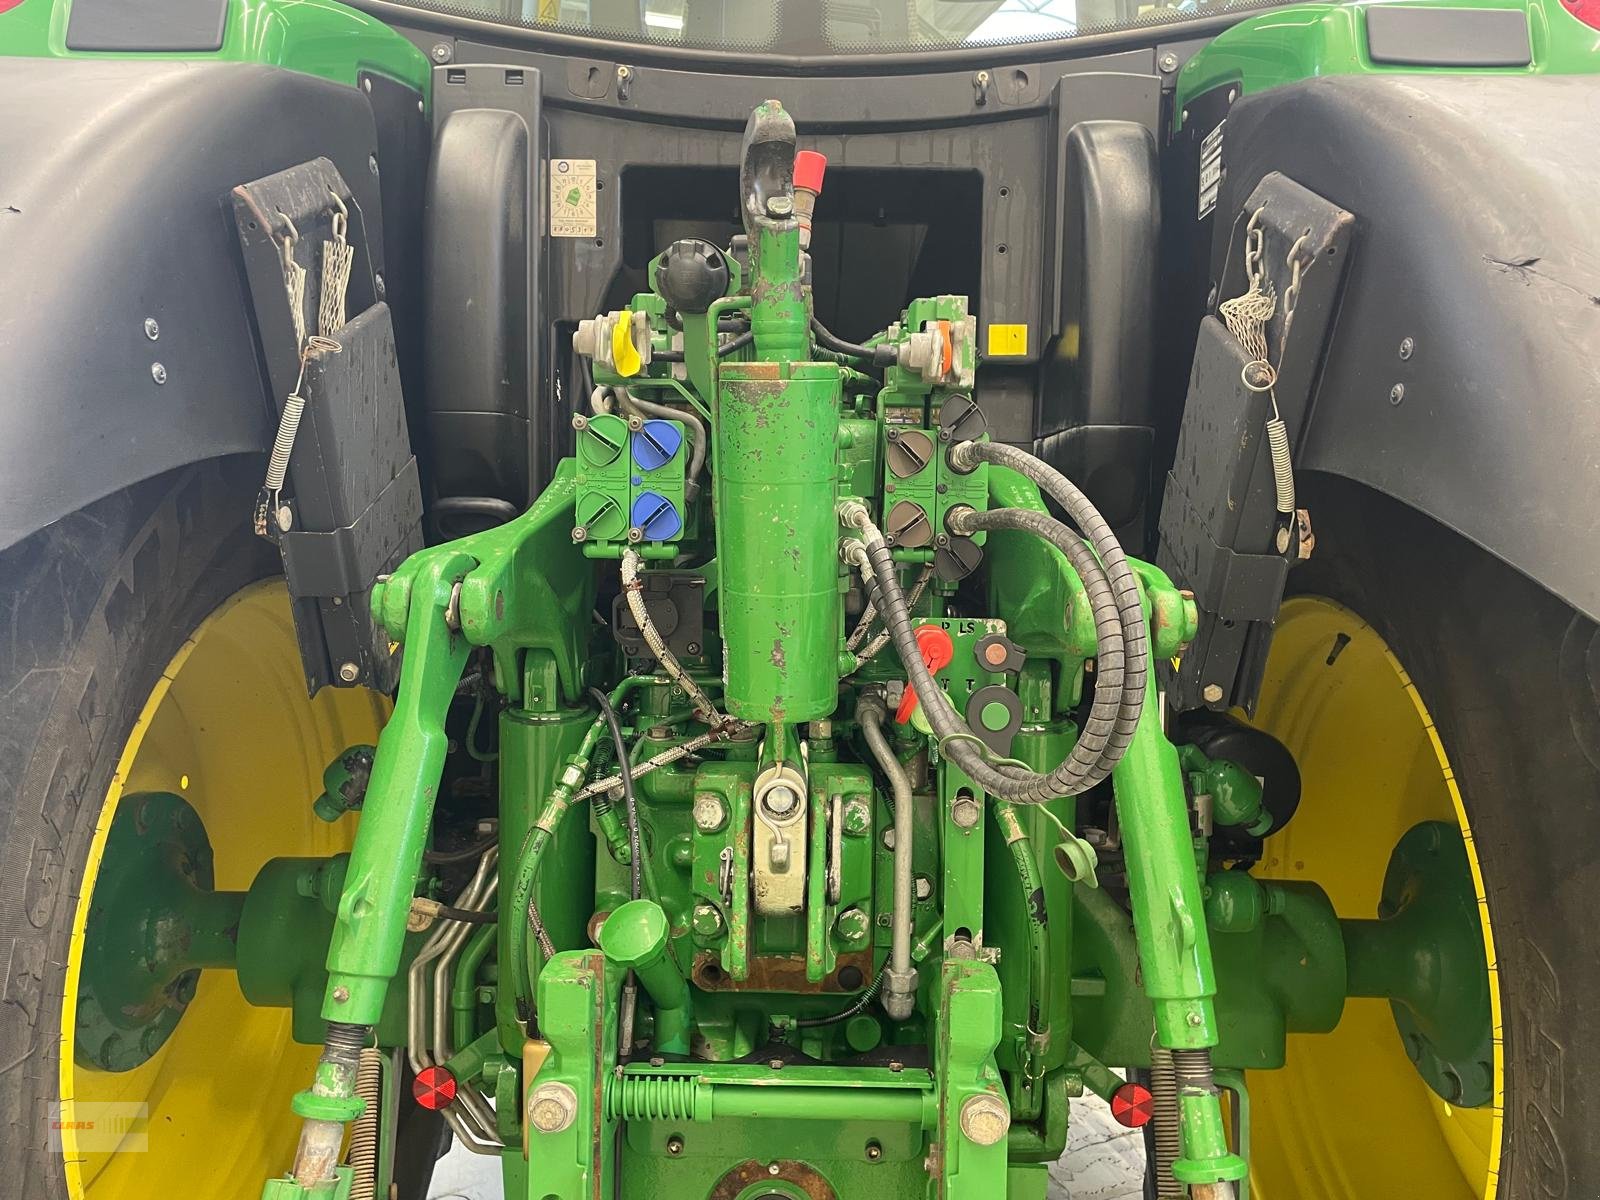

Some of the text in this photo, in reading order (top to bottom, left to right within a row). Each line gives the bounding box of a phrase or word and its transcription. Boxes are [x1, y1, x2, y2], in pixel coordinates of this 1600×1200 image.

[960, 621, 975, 634] LS
[941, 678, 975, 690] T T
